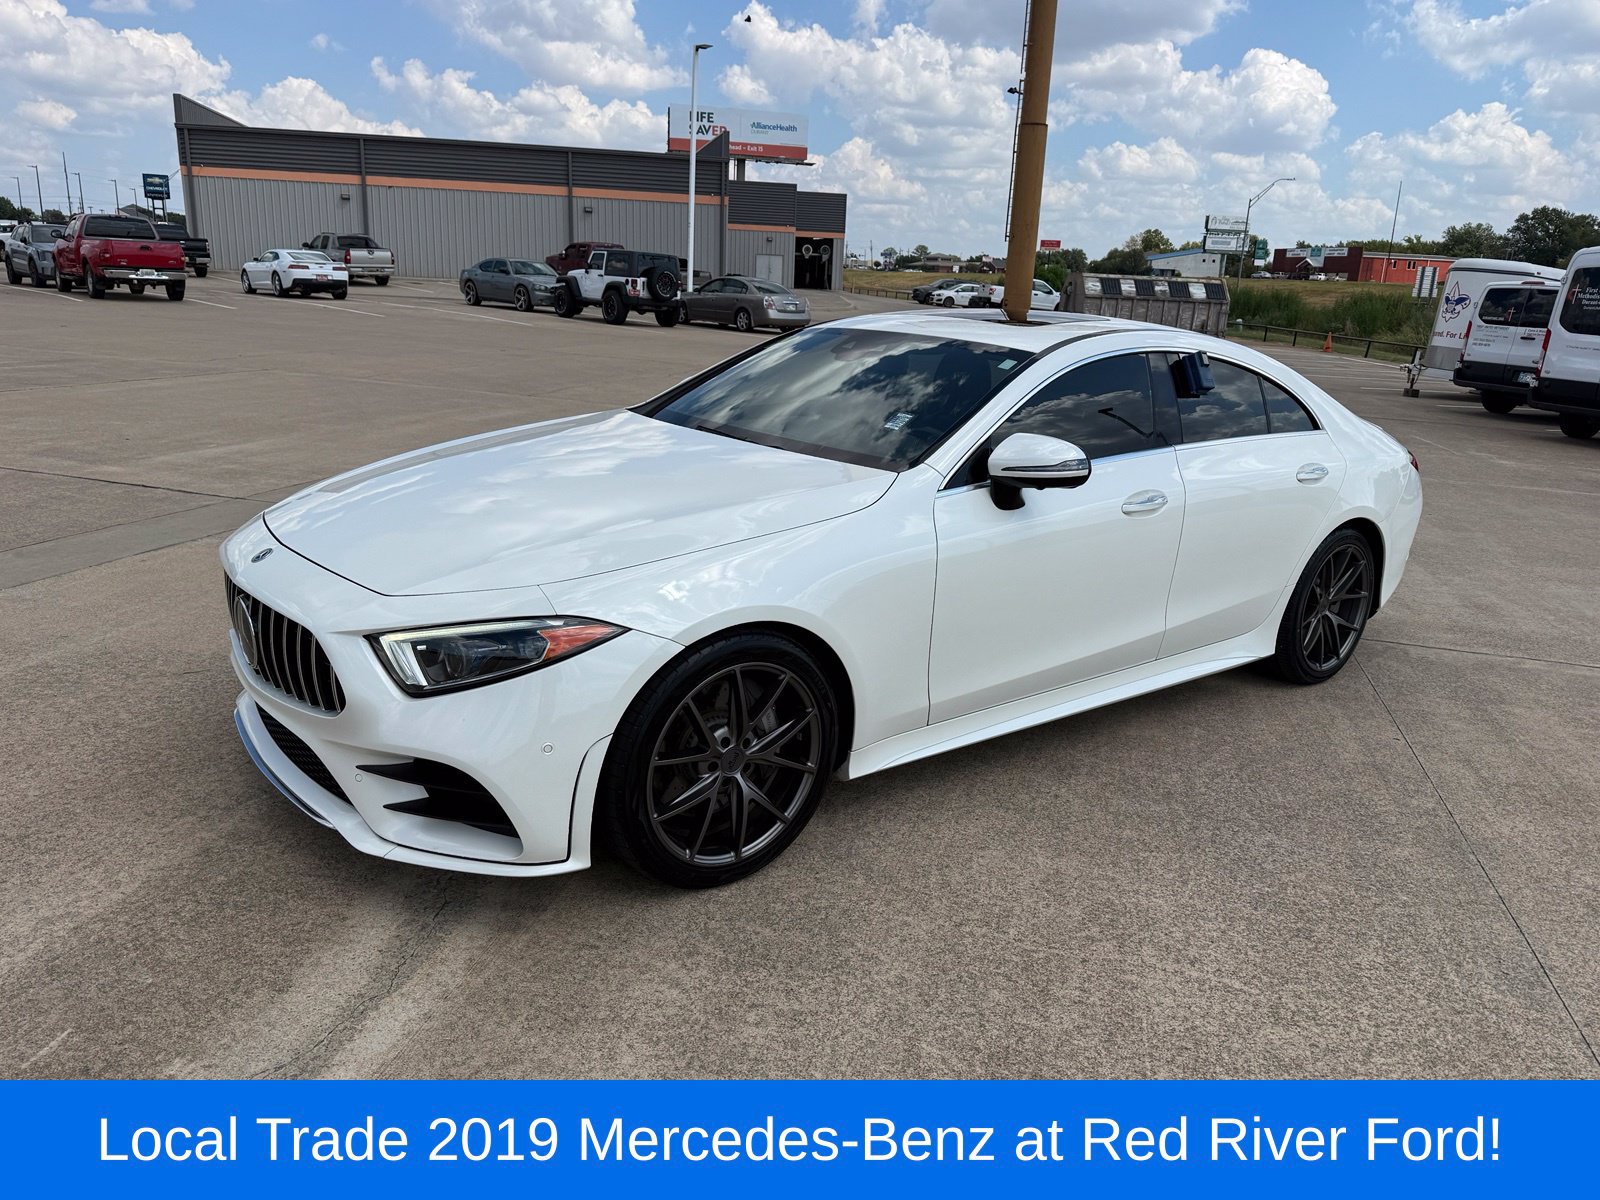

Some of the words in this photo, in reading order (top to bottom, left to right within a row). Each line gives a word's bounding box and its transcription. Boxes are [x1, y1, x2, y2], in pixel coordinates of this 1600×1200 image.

[689, 124, 727, 136] AVE
[751, 121, 798, 132] AllianceHealth
[1577, 292, 1600, 300] Methodis
[1445, 331, 1458, 339] For
